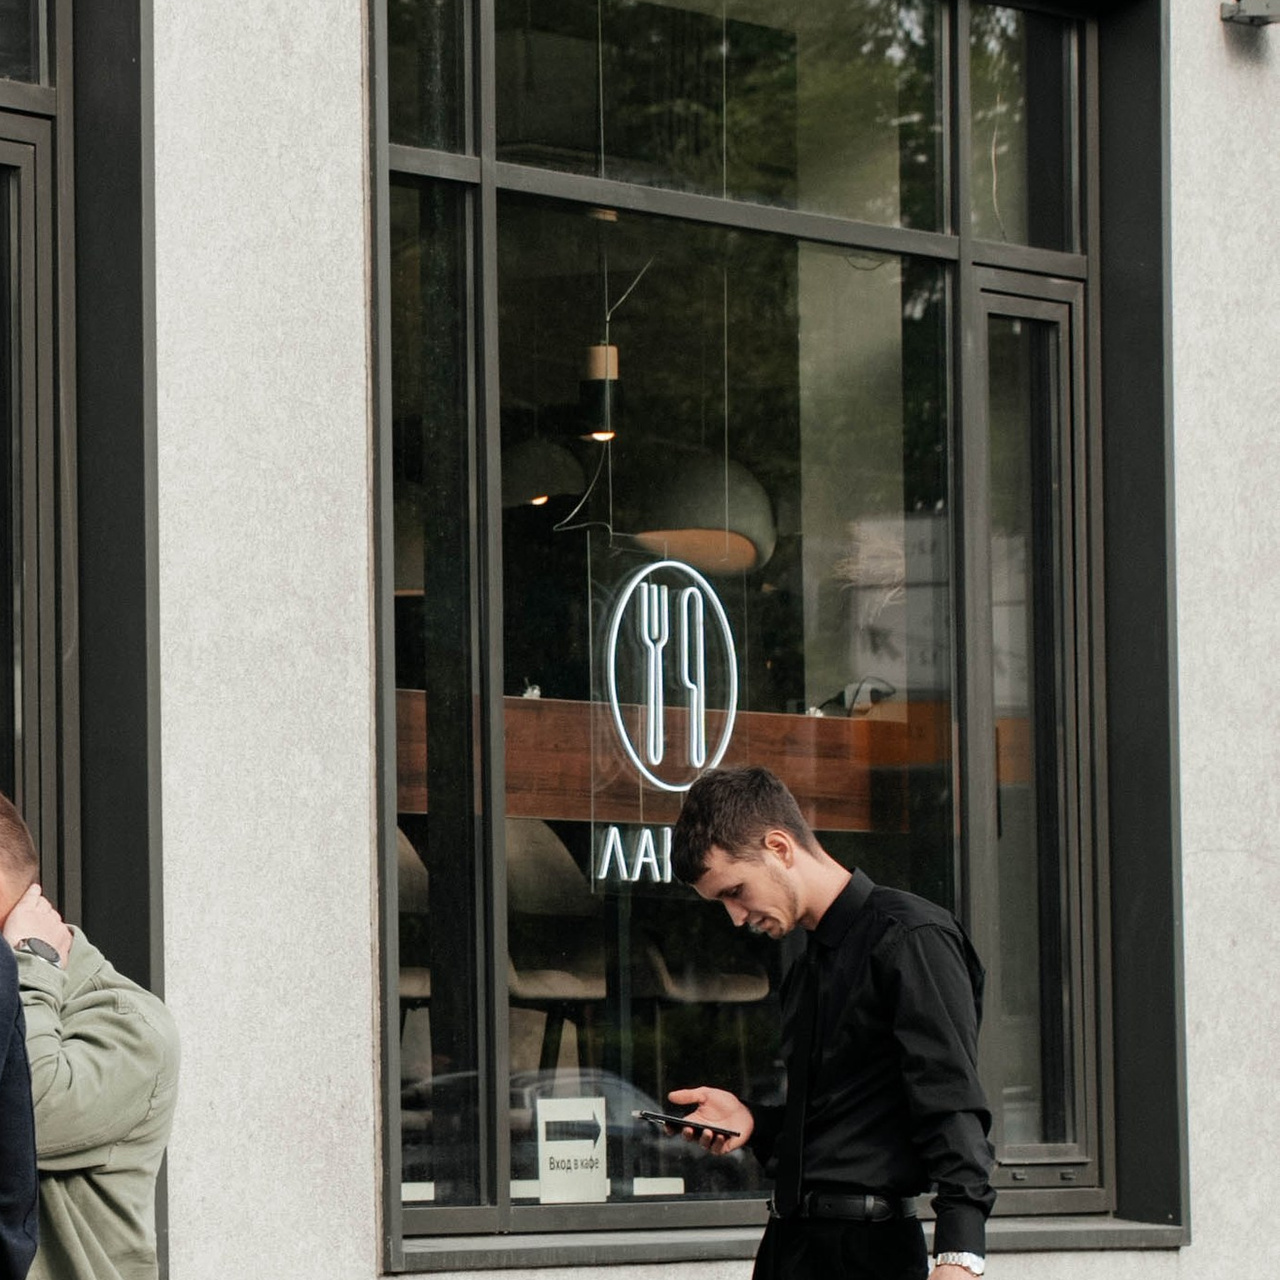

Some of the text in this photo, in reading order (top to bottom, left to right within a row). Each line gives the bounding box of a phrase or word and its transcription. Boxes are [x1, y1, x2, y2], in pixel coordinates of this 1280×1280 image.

[597, 825, 672, 884] ЛА
[549, 1156, 600, 1173] Вход в кафе
